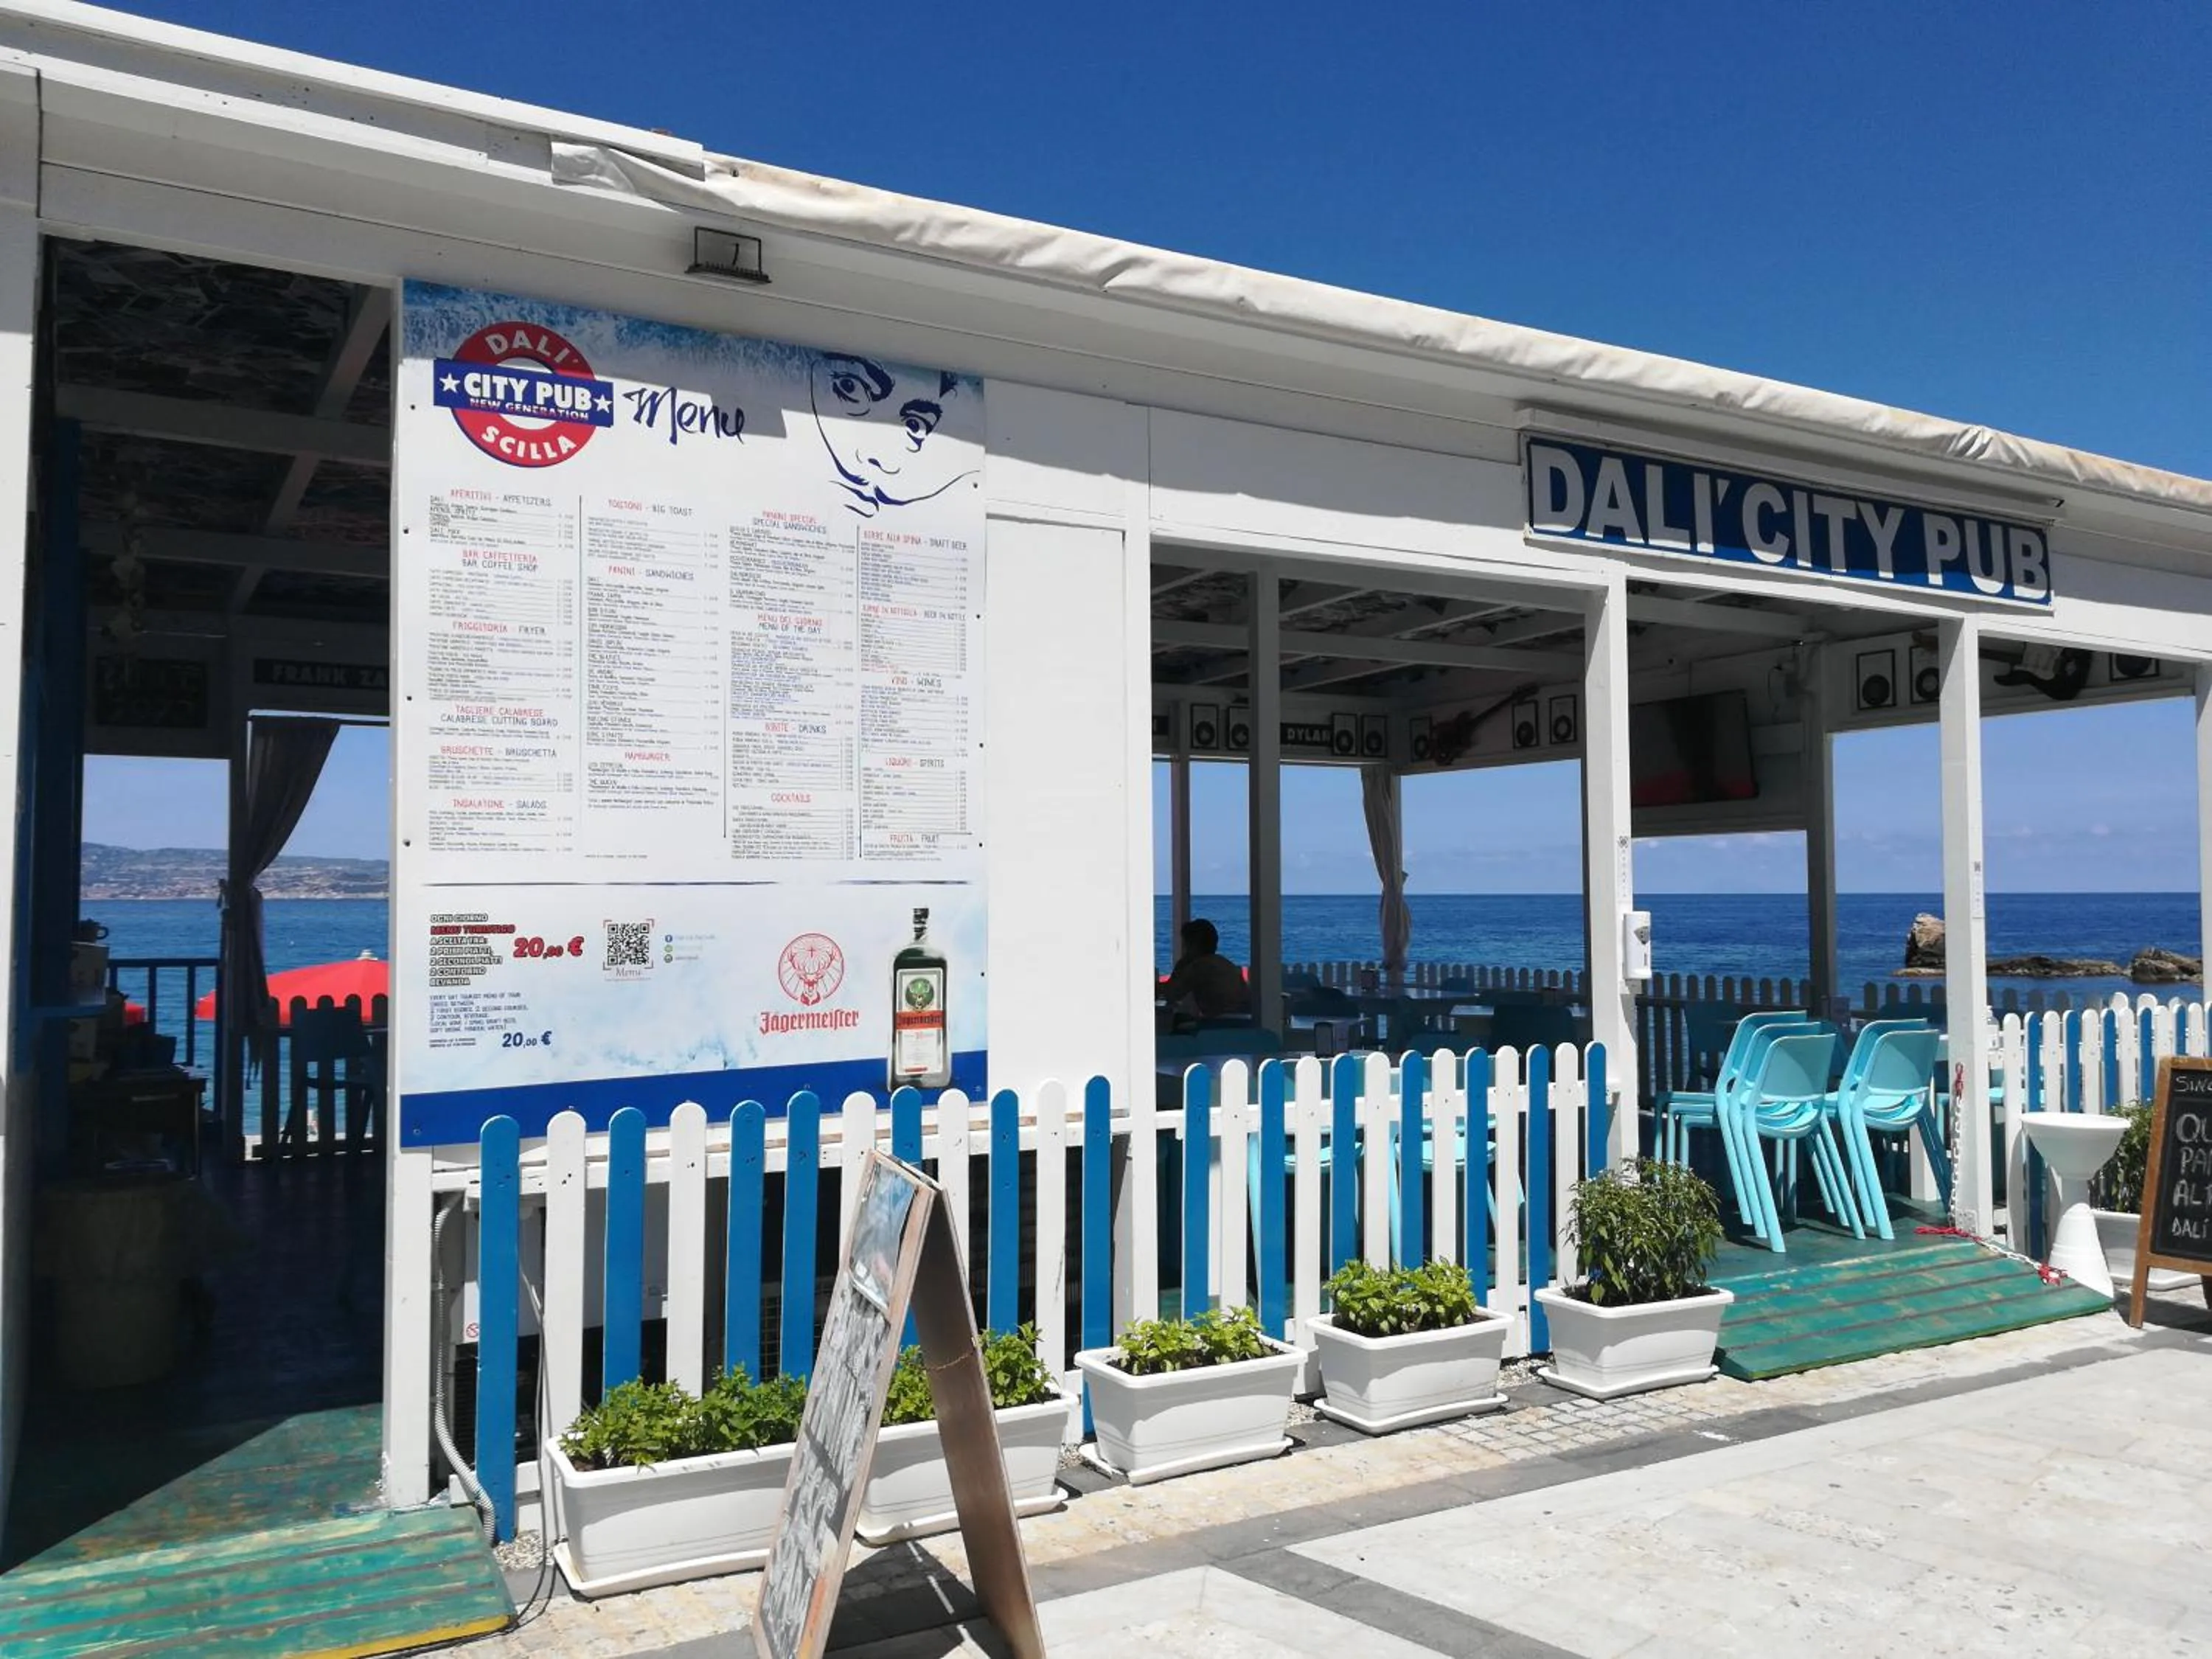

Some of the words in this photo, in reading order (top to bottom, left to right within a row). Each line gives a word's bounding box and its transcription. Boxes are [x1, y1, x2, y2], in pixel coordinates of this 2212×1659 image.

[463, 372, 529, 402] CITY
[536, 380, 592, 411] PUB
[470, 397, 501, 408] NEW
[505, 402, 589, 420] GENERATION
[622, 386, 744, 445] Menu
[481, 425, 577, 460] SCILLA
[450, 489, 492, 501] APERITIVI
[652, 504, 666, 514] BIG
[669, 506, 693, 516] TOAST
[753, 518, 780, 529] SPECIAL
[886, 532, 900, 542] ALLA
[928, 538, 950, 549] DRAFT
[951, 540, 967, 551] BEER
[1741, 484, 1905, 580] CITY
[1922, 512, 2048, 600] PUB
[462, 549, 479, 558] BAR
[483, 550, 538, 563] CAFFETTERIA
[462, 558, 479, 567] BAR
[481, 560, 512, 571] COFFEE
[517, 563, 539, 572] SHOP
[608, 566, 636, 576] PANINI
[757, 613, 778, 623] MENU
[452, 621, 509, 633] FRIGGITORIA
[518, 625, 546, 635] FRYER
[758, 622, 779, 631] MENU
[781, 624, 790, 632] OF
[793, 625, 806, 633] THE
[807, 626, 821, 634] DAY
[272, 664, 347, 685] FRANK
[917, 677, 942, 688] WINES
[454, 704, 494, 716] TAGLIERE
[498, 707, 544, 717] CALABRESE
[440, 714, 487, 724] CALABRESE
[491, 716, 527, 726] CUTTING
[530, 718, 558, 727] BOARD
[798, 724, 827, 734] DRINKS
[440, 745, 494, 756] BRUSCHETTE
[505, 748, 557, 758] BRUSCHETTA
[919, 759, 945, 768] SPIRITS
[516, 800, 548, 809] SALADS
[771, 793, 812, 803] COCKTAILS
[921, 835, 940, 844] FRUIT
[430, 913, 453, 922] OGNI
[453, 913, 489, 922] GIORNO
[567, 936, 585, 956] €
[502, 1032, 538, 1048] 20,00
[540, 1030, 553, 1046] €
